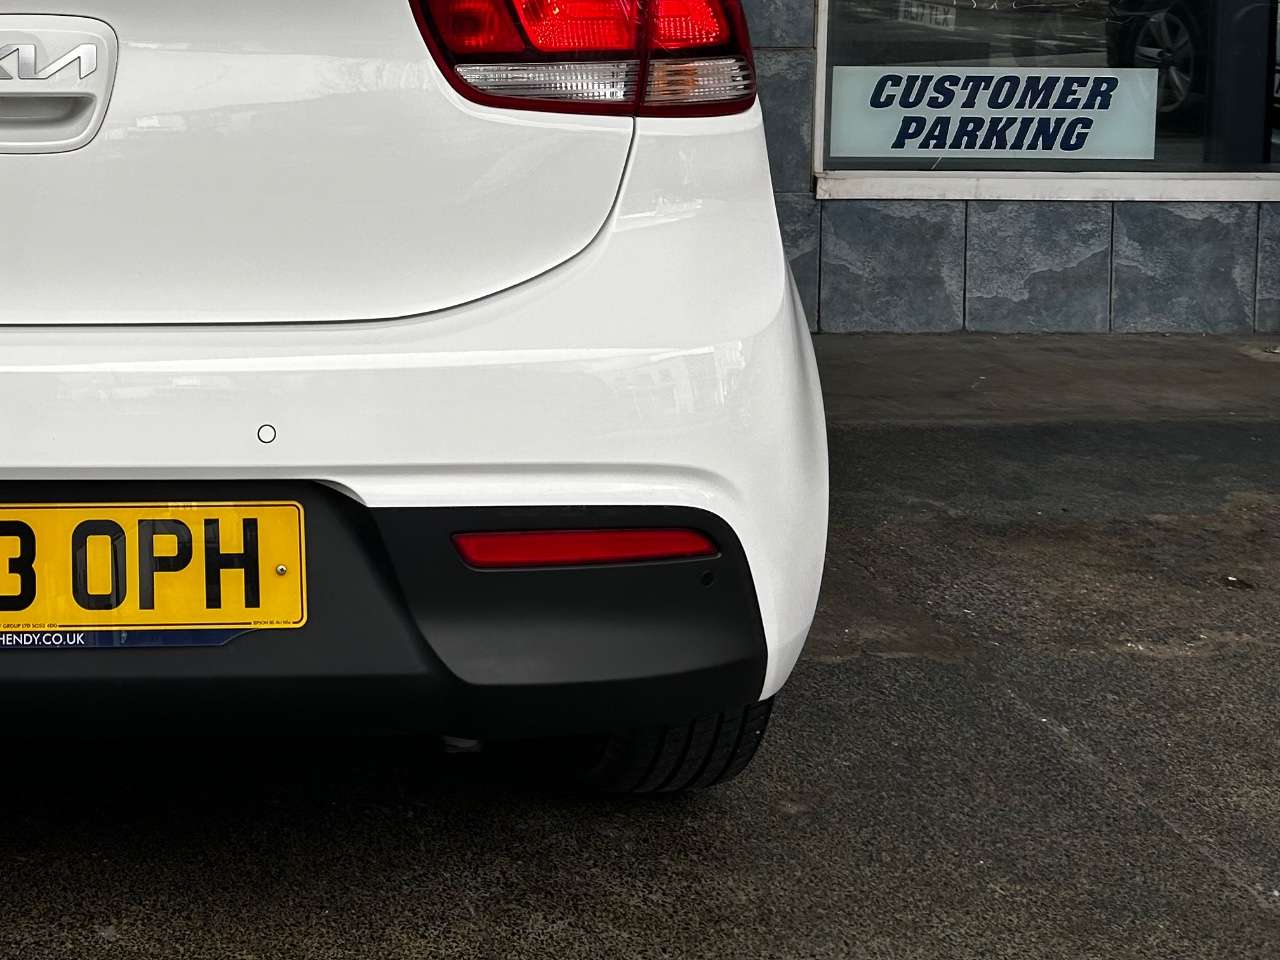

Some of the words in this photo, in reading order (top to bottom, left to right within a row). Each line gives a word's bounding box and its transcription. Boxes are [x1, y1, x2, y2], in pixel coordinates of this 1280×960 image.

[869, 72, 1120, 111] CUSTOMER
[890, 115, 1094, 152] PARKING
[70, 517, 261, 613] OPH
